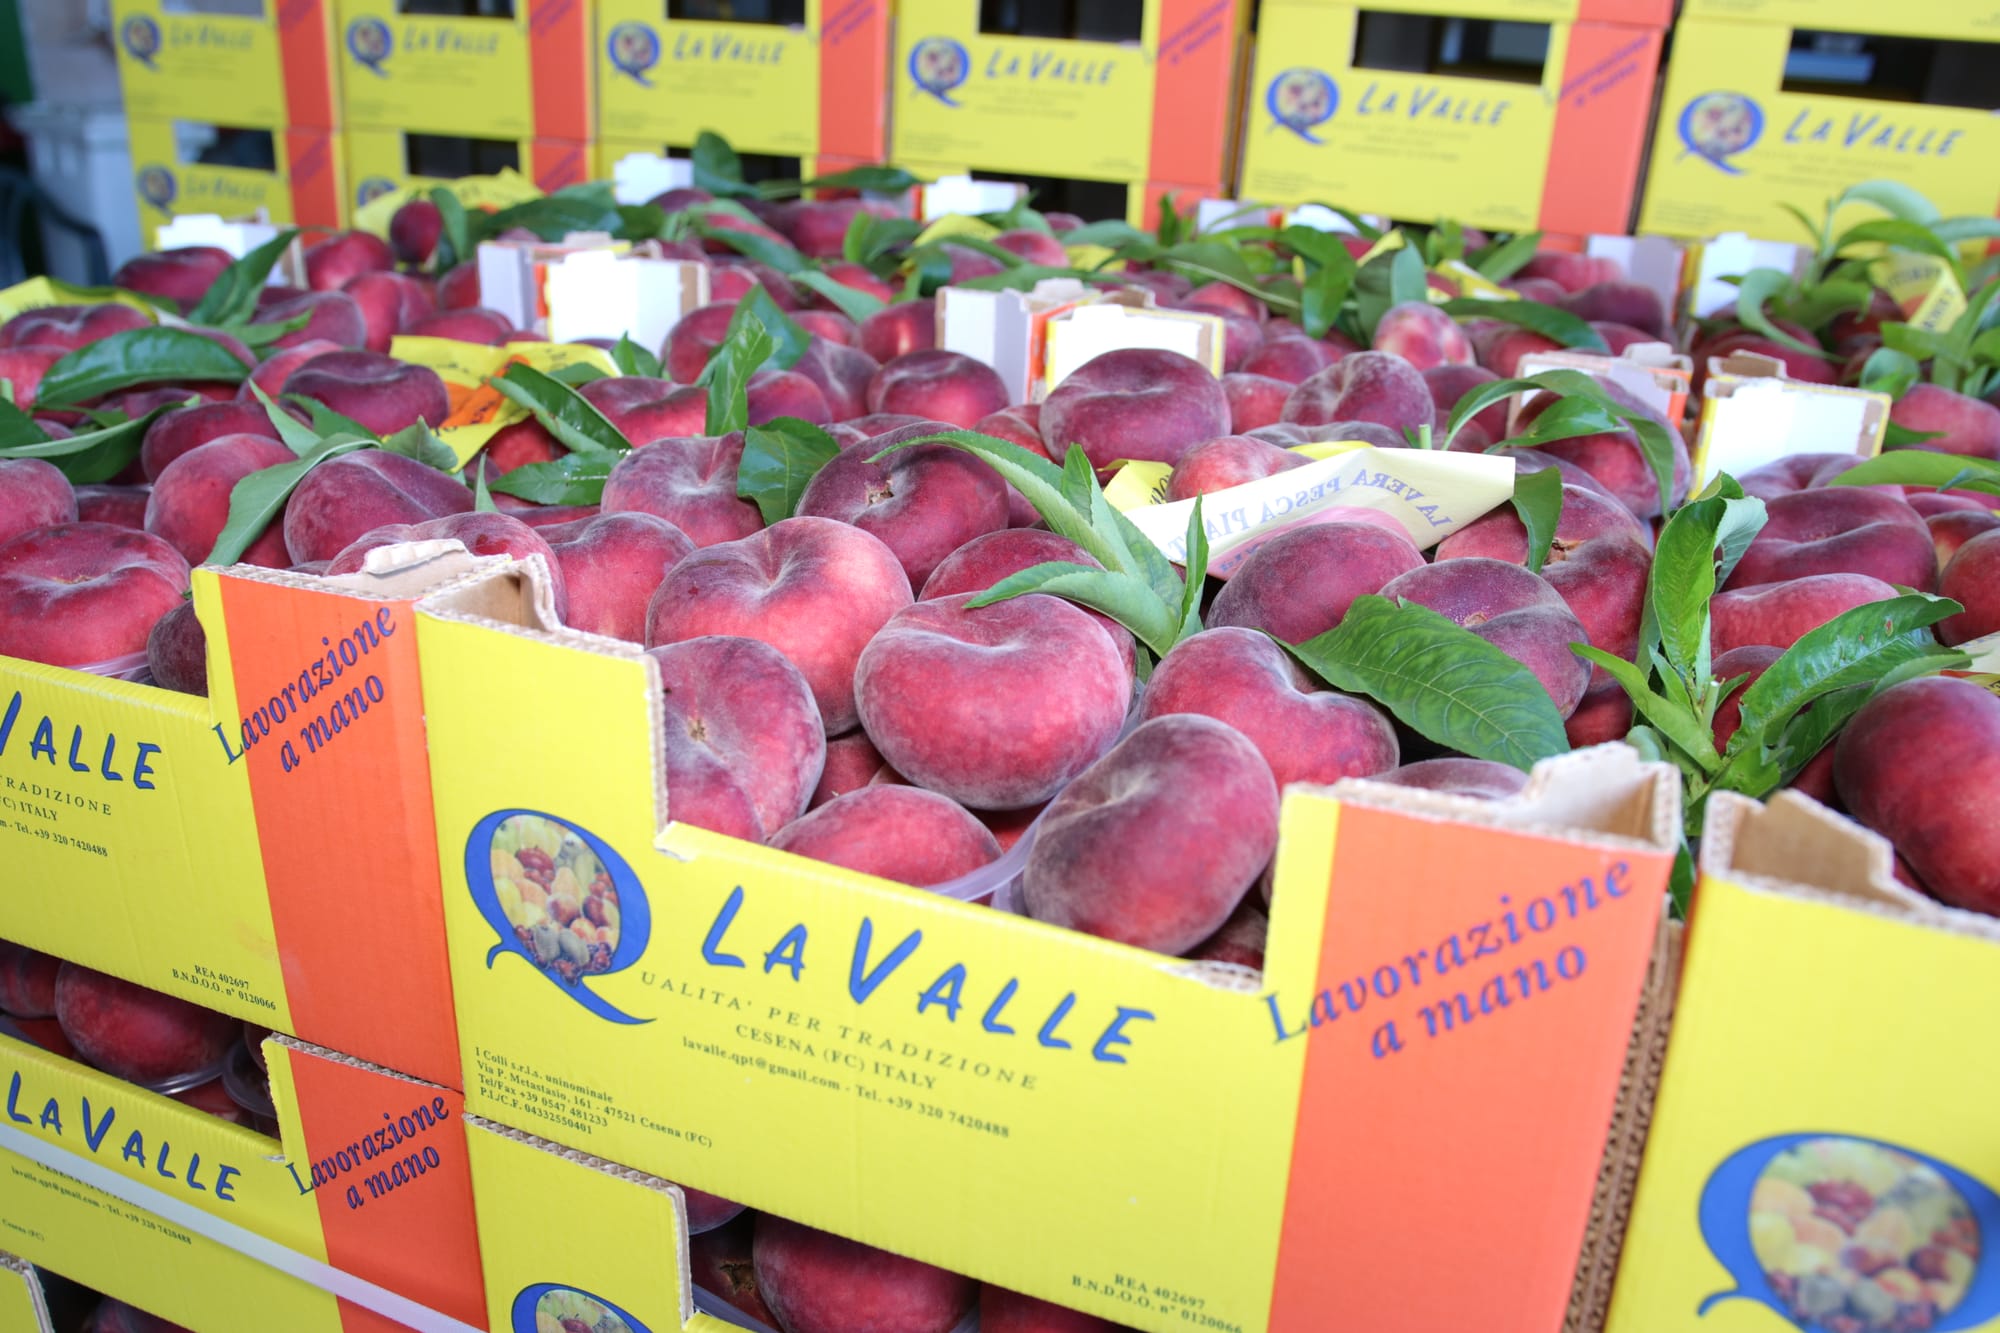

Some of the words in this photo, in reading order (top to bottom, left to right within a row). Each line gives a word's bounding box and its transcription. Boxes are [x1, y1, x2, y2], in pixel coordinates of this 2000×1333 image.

[211, 605, 397, 764] Lavorazione
[280, 741, 301, 773] a
[302, 674, 386, 756] mano
[0, 776, 112, 815] RADIZIONE
[20, 801, 58, 821] ITALY
[15, 821, 32, 835] Tel.
[34, 828, 50, 840] +39
[194, 964, 216, 980] REA
[218, 973, 249, 989] 402697
[1261, 857, 1634, 1046] Lavorazione
[1370, 1024, 1404, 1060] a
[1418, 943, 1588, 1039] mano
[483, 1049, 508, 1067] Colli
[545, 1073, 613, 1103] uninominale
[736, 1024, 817, 1059] CESENA
[823, 1047, 866, 1073] (FC)
[873, 1061, 937, 1090] ITALY
[768, 1006, 821, 1033] PER
[838, 1025, 1037, 1091] TRADIZIONE
[476, 1060, 494, 1075] Via
[574, 1096, 592, 1109] 161
[604, 1105, 636, 1124] 47521
[640, 1116, 681, 1139] Cesena
[684, 1130, 712, 1149] (FC)
[478, 1073, 516, 1096] Tel/Fax
[520, 1090, 538, 1103] +39
[541, 1097, 566, 1113] 0547
[570, 1104, 608, 1127] 481233
[683, 1036, 841, 1091] lavalle.qpt@gmail.com
[855, 1083, 882, 1104] Tel.
[887, 1096, 913, 1112] +39
[918, 1102, 944, 1120] 320
[948, 1109, 1011, 1139] 7420488
[285, 1096, 449, 1195] Lavorazione
[346, 1184, 364, 1209] a
[364, 1146, 440, 1198] mano
[1115, 1273, 1147, 1293] REA
[1153, 1287, 1205, 1309] 402697
[1181, 1308, 1243, 1333] 0120066
